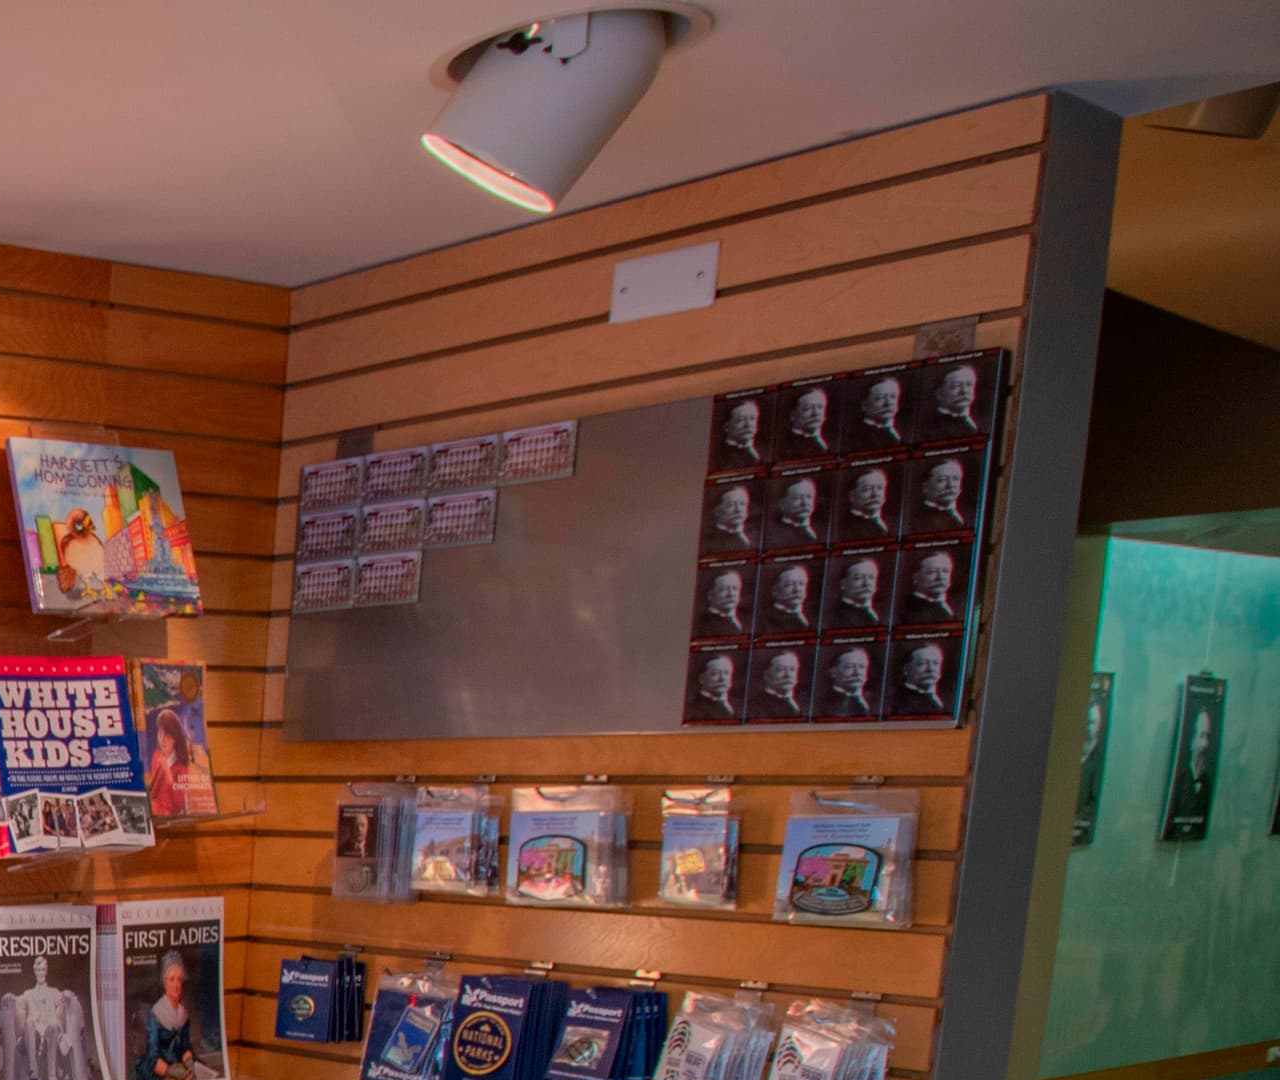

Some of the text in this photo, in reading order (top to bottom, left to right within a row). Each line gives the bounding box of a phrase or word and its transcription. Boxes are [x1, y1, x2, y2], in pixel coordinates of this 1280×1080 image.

[40, 454, 122, 471] HARRIETT'S
[34, 468, 133, 489] HOMECOMING
[3, 739, 91, 768] KIDS
[125, 926, 218, 949] FIRST LADIES
[294, 972, 329, 983] Passport
[475, 990, 525, 1009] Passport
[461, 1029, 504, 1049] NATIONAL
[465, 1045, 495, 1060] PARKS
